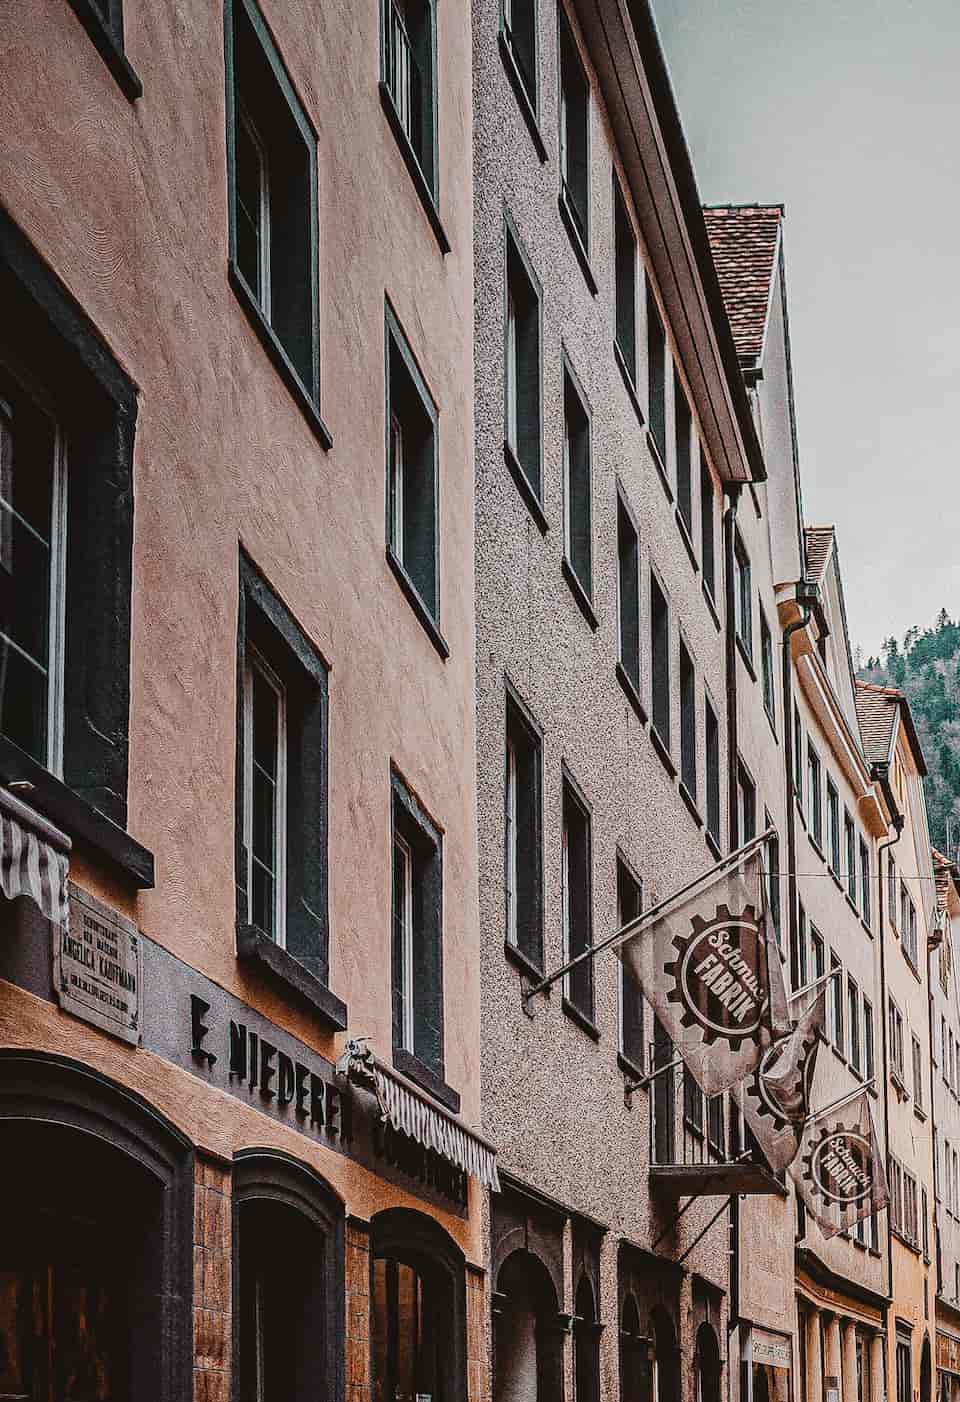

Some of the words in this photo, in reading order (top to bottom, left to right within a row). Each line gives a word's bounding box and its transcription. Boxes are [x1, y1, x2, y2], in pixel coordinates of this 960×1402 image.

[694, 953, 756, 1023] FABRIK
[820, 1151, 858, 1194] FABRIK
[830, 1137, 871, 1185] Schmuck
